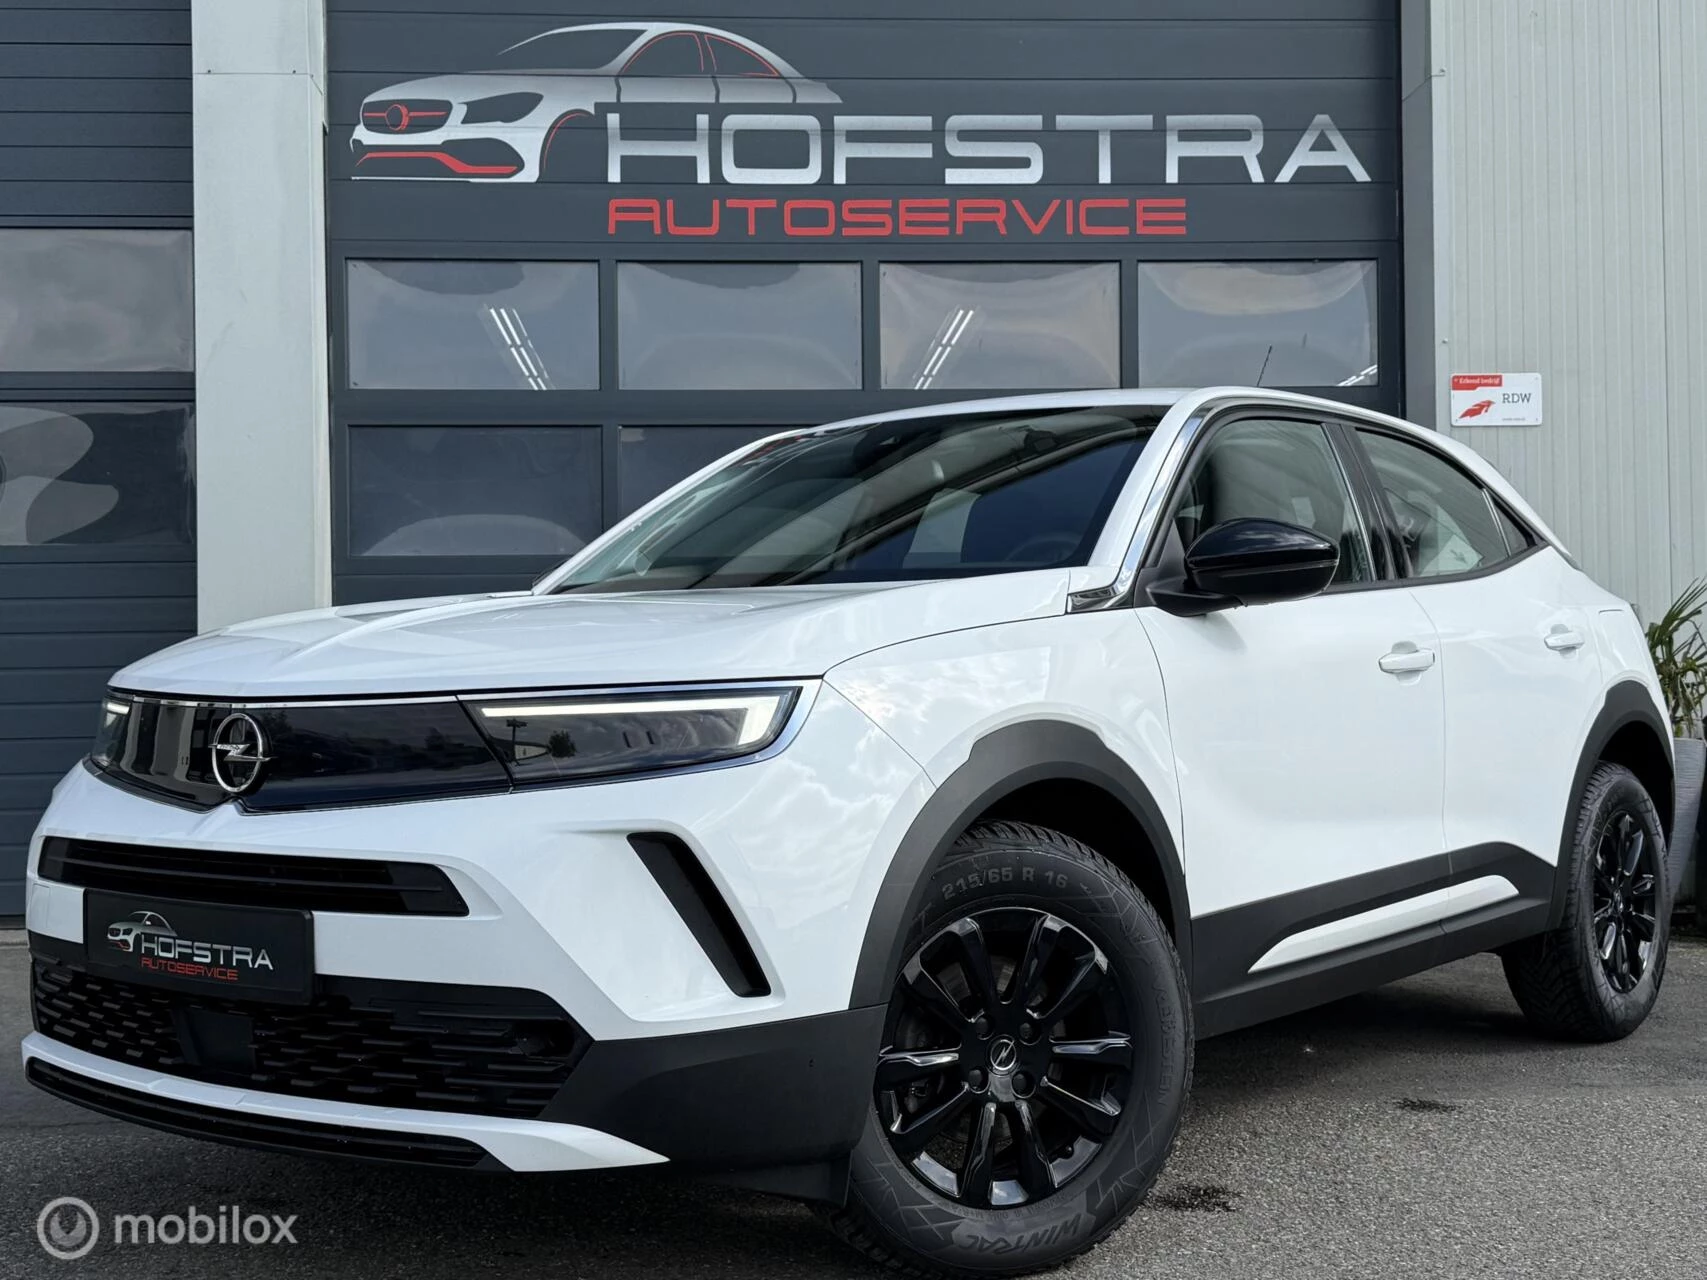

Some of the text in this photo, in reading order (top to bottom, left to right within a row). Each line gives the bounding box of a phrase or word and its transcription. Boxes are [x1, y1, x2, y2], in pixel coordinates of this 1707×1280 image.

[606, 112, 1372, 185] HOFSTRA
[607, 198, 1187, 236] AUTOSERVICE
[1502, 392, 1532, 404] RDW
[941, 866, 1069, 899] 215/65 R 16
[141, 933, 274, 971] HOFSTRA
[141, 956, 239, 981] AUTOSERVICE
[958, 1212, 1083, 1255] WINTRAC
